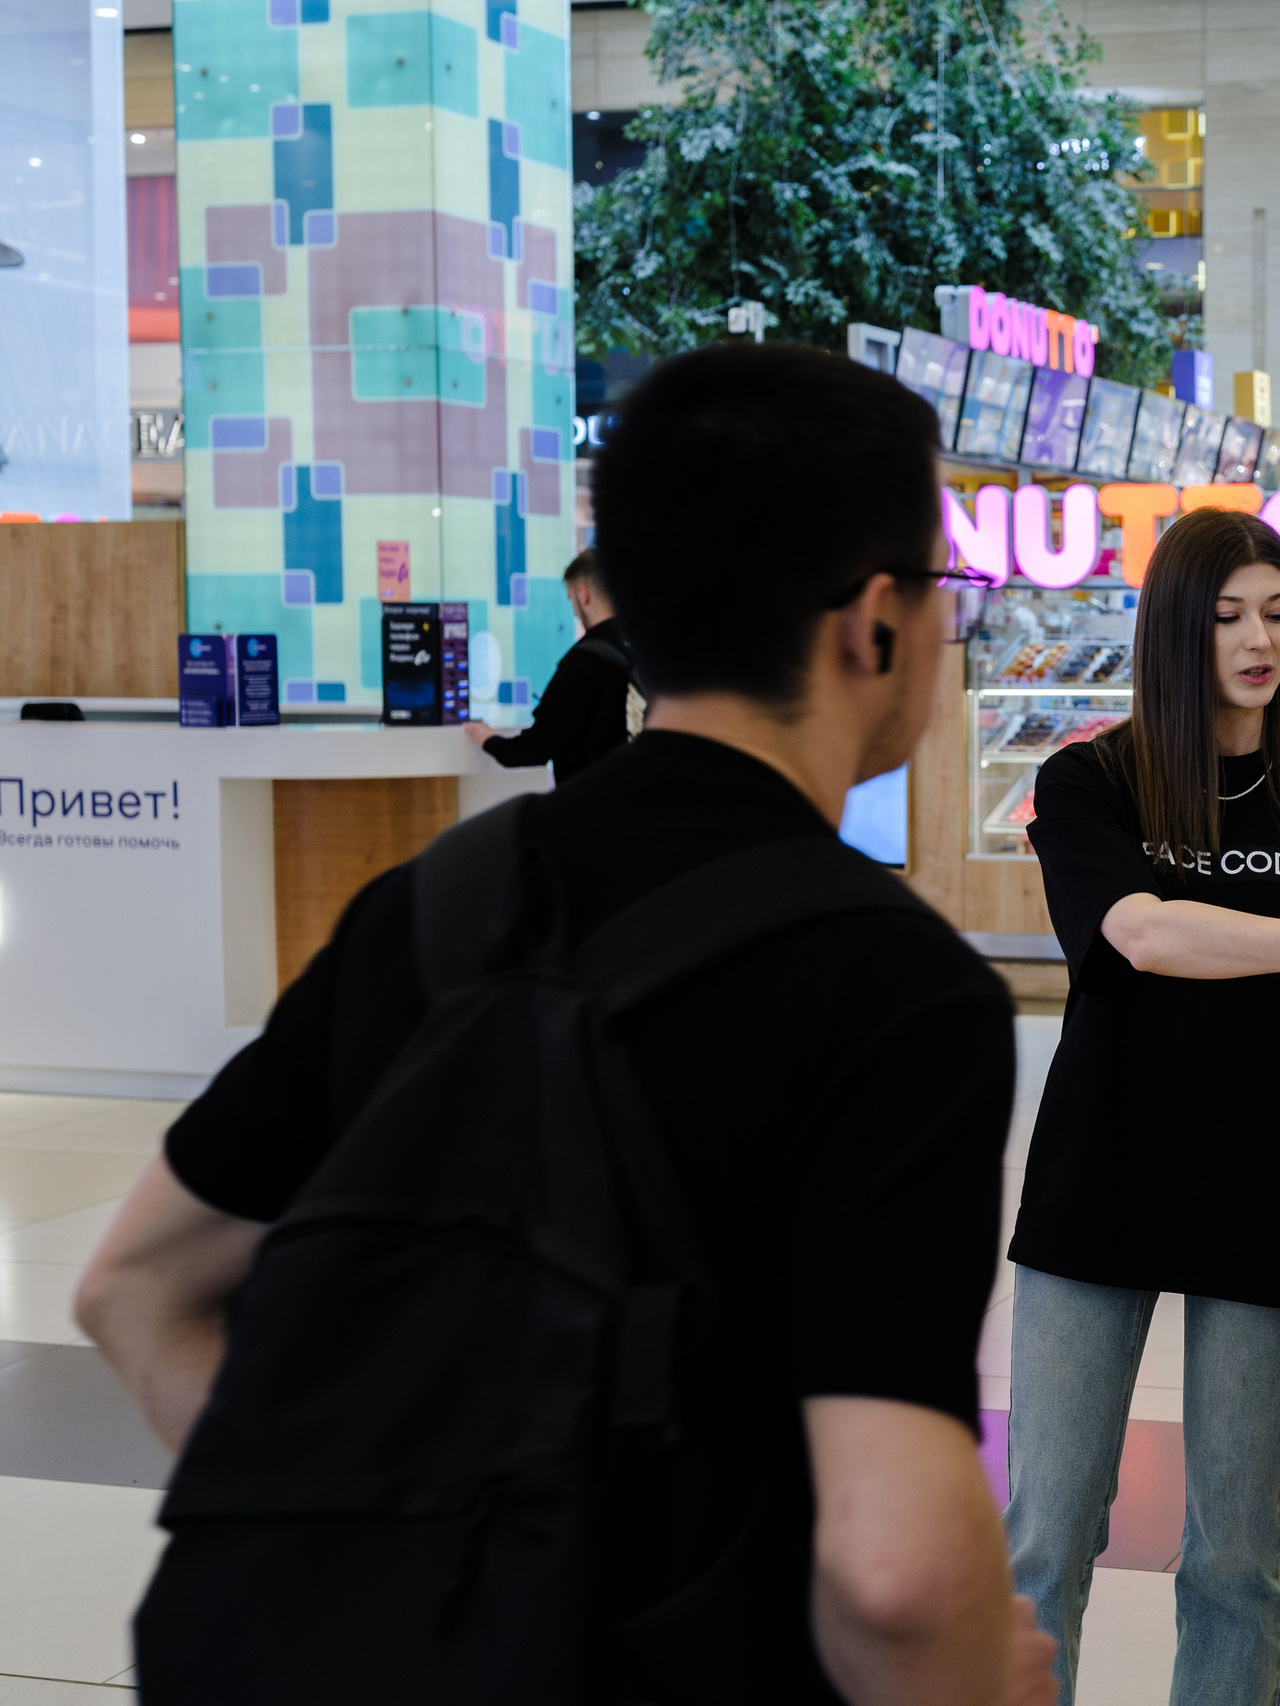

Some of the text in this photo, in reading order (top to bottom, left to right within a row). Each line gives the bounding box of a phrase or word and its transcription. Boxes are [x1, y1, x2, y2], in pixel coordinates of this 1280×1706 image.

[968, 286, 1096, 378] DONUTTO
[0, 778, 180, 828] Привет!
[57, 832, 114, 848] готовы
[118, 834, 181, 850] помочь
[1142, 840, 1212, 875] FACE
